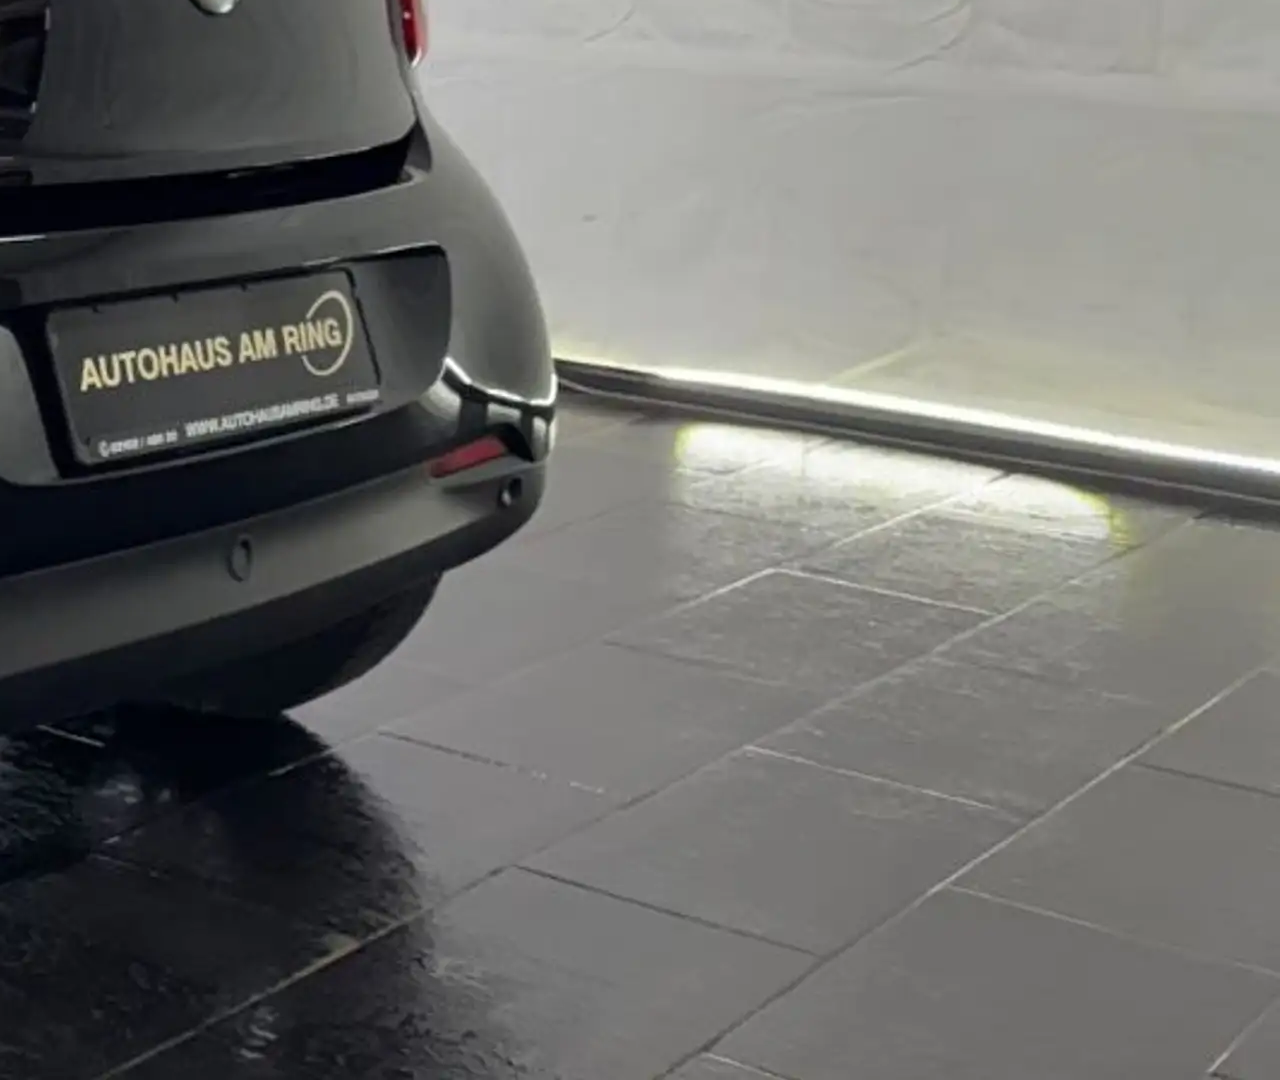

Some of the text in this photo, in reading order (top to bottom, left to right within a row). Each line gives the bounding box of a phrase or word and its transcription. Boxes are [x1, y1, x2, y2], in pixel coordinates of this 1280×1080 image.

[80, 318, 342, 391] AUTOHAUS AM RING
